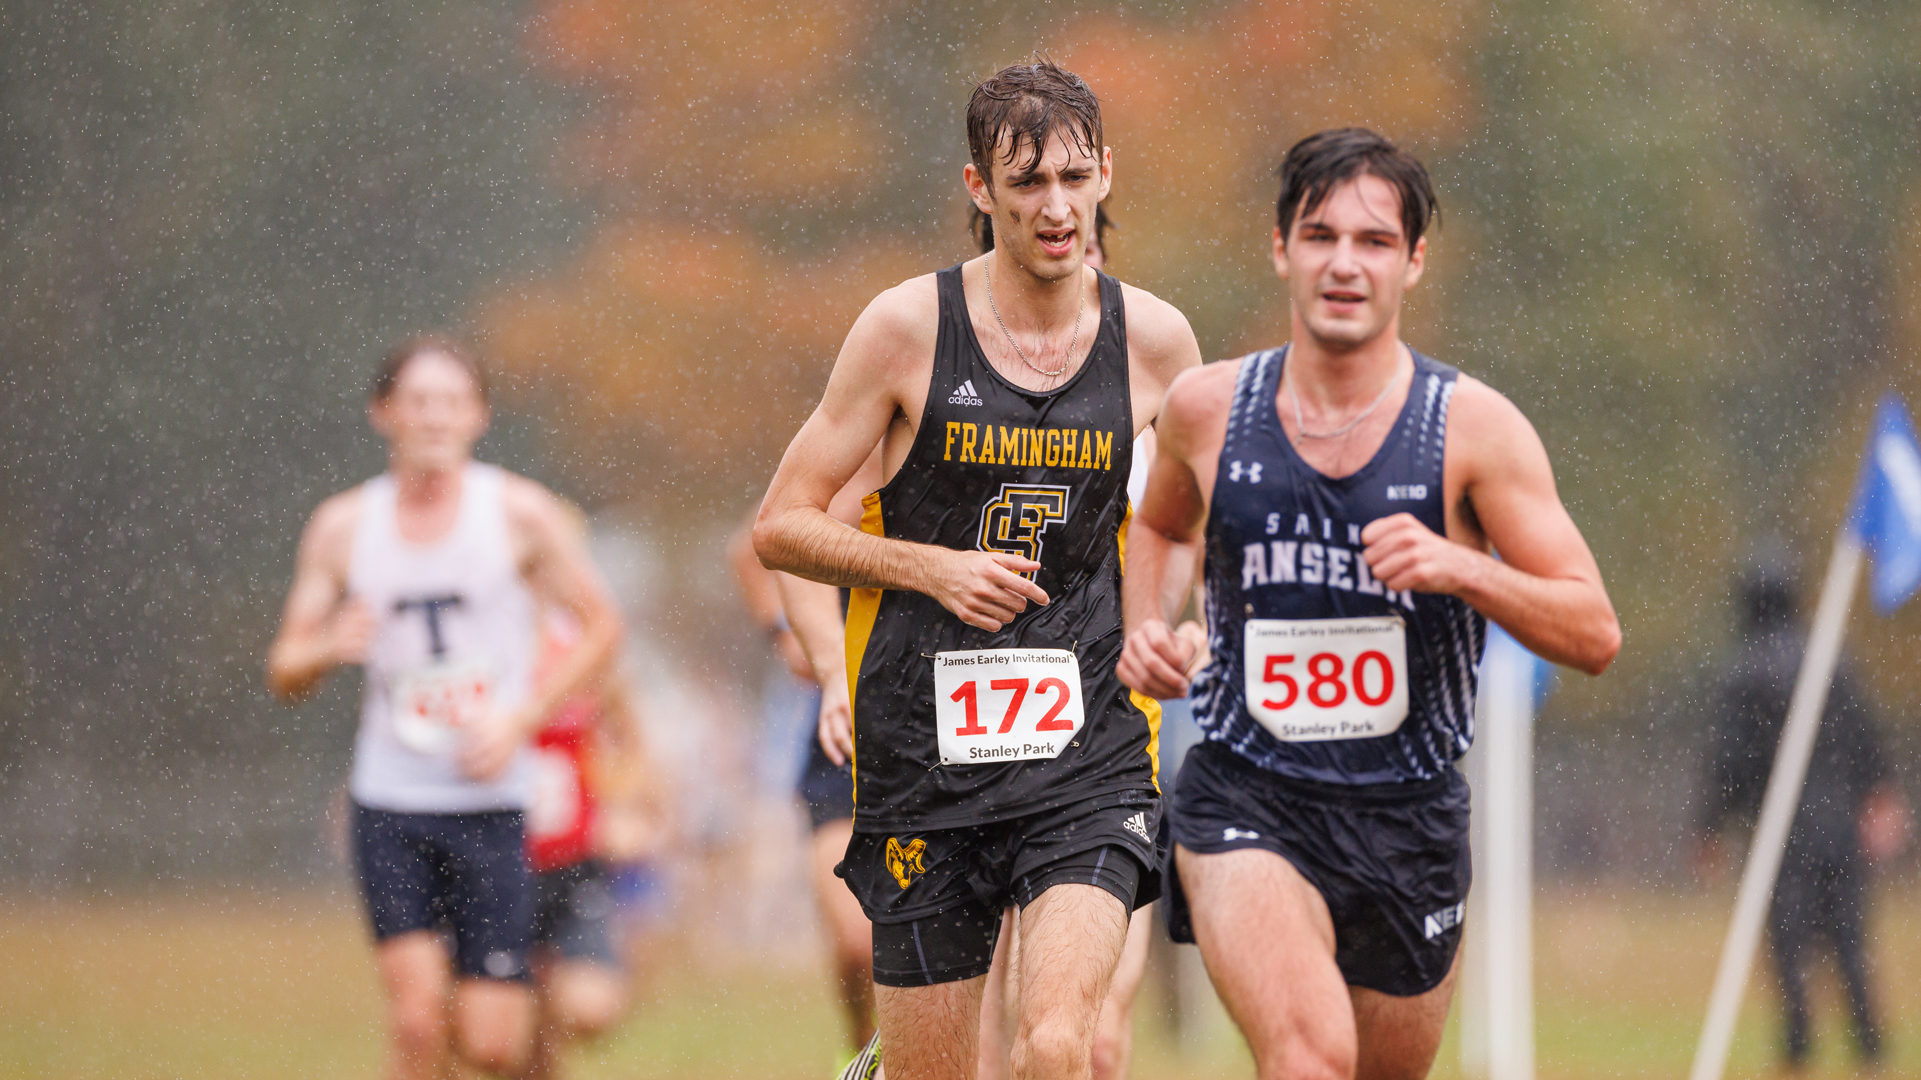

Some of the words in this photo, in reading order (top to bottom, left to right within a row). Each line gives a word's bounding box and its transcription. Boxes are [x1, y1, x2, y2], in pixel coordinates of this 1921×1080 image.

[948, 395, 983, 407] adidas
[943, 421, 1114, 471] FRAMINGHAM
[1266, 512, 1361, 546] SAIN
[393, 594, 464, 657] T
[1254, 626, 1288, 637] James
[1291, 626, 1325, 637] Earley
[943, 656, 975, 667] James
[978, 652, 1010, 665] Earley
[1012, 653, 1070, 664] Invitational
[1262, 650, 1394, 711] 580
[950, 677, 1074, 737] 172
[1282, 723, 1338, 737] Stanley
[1341, 721, 1375, 734] Park
[969, 744, 1020, 759] Stanley
[1023, 742, 1055, 755] Park
[1123, 821, 1151, 843] adidas
[1424, 901, 1464, 940] NE1
